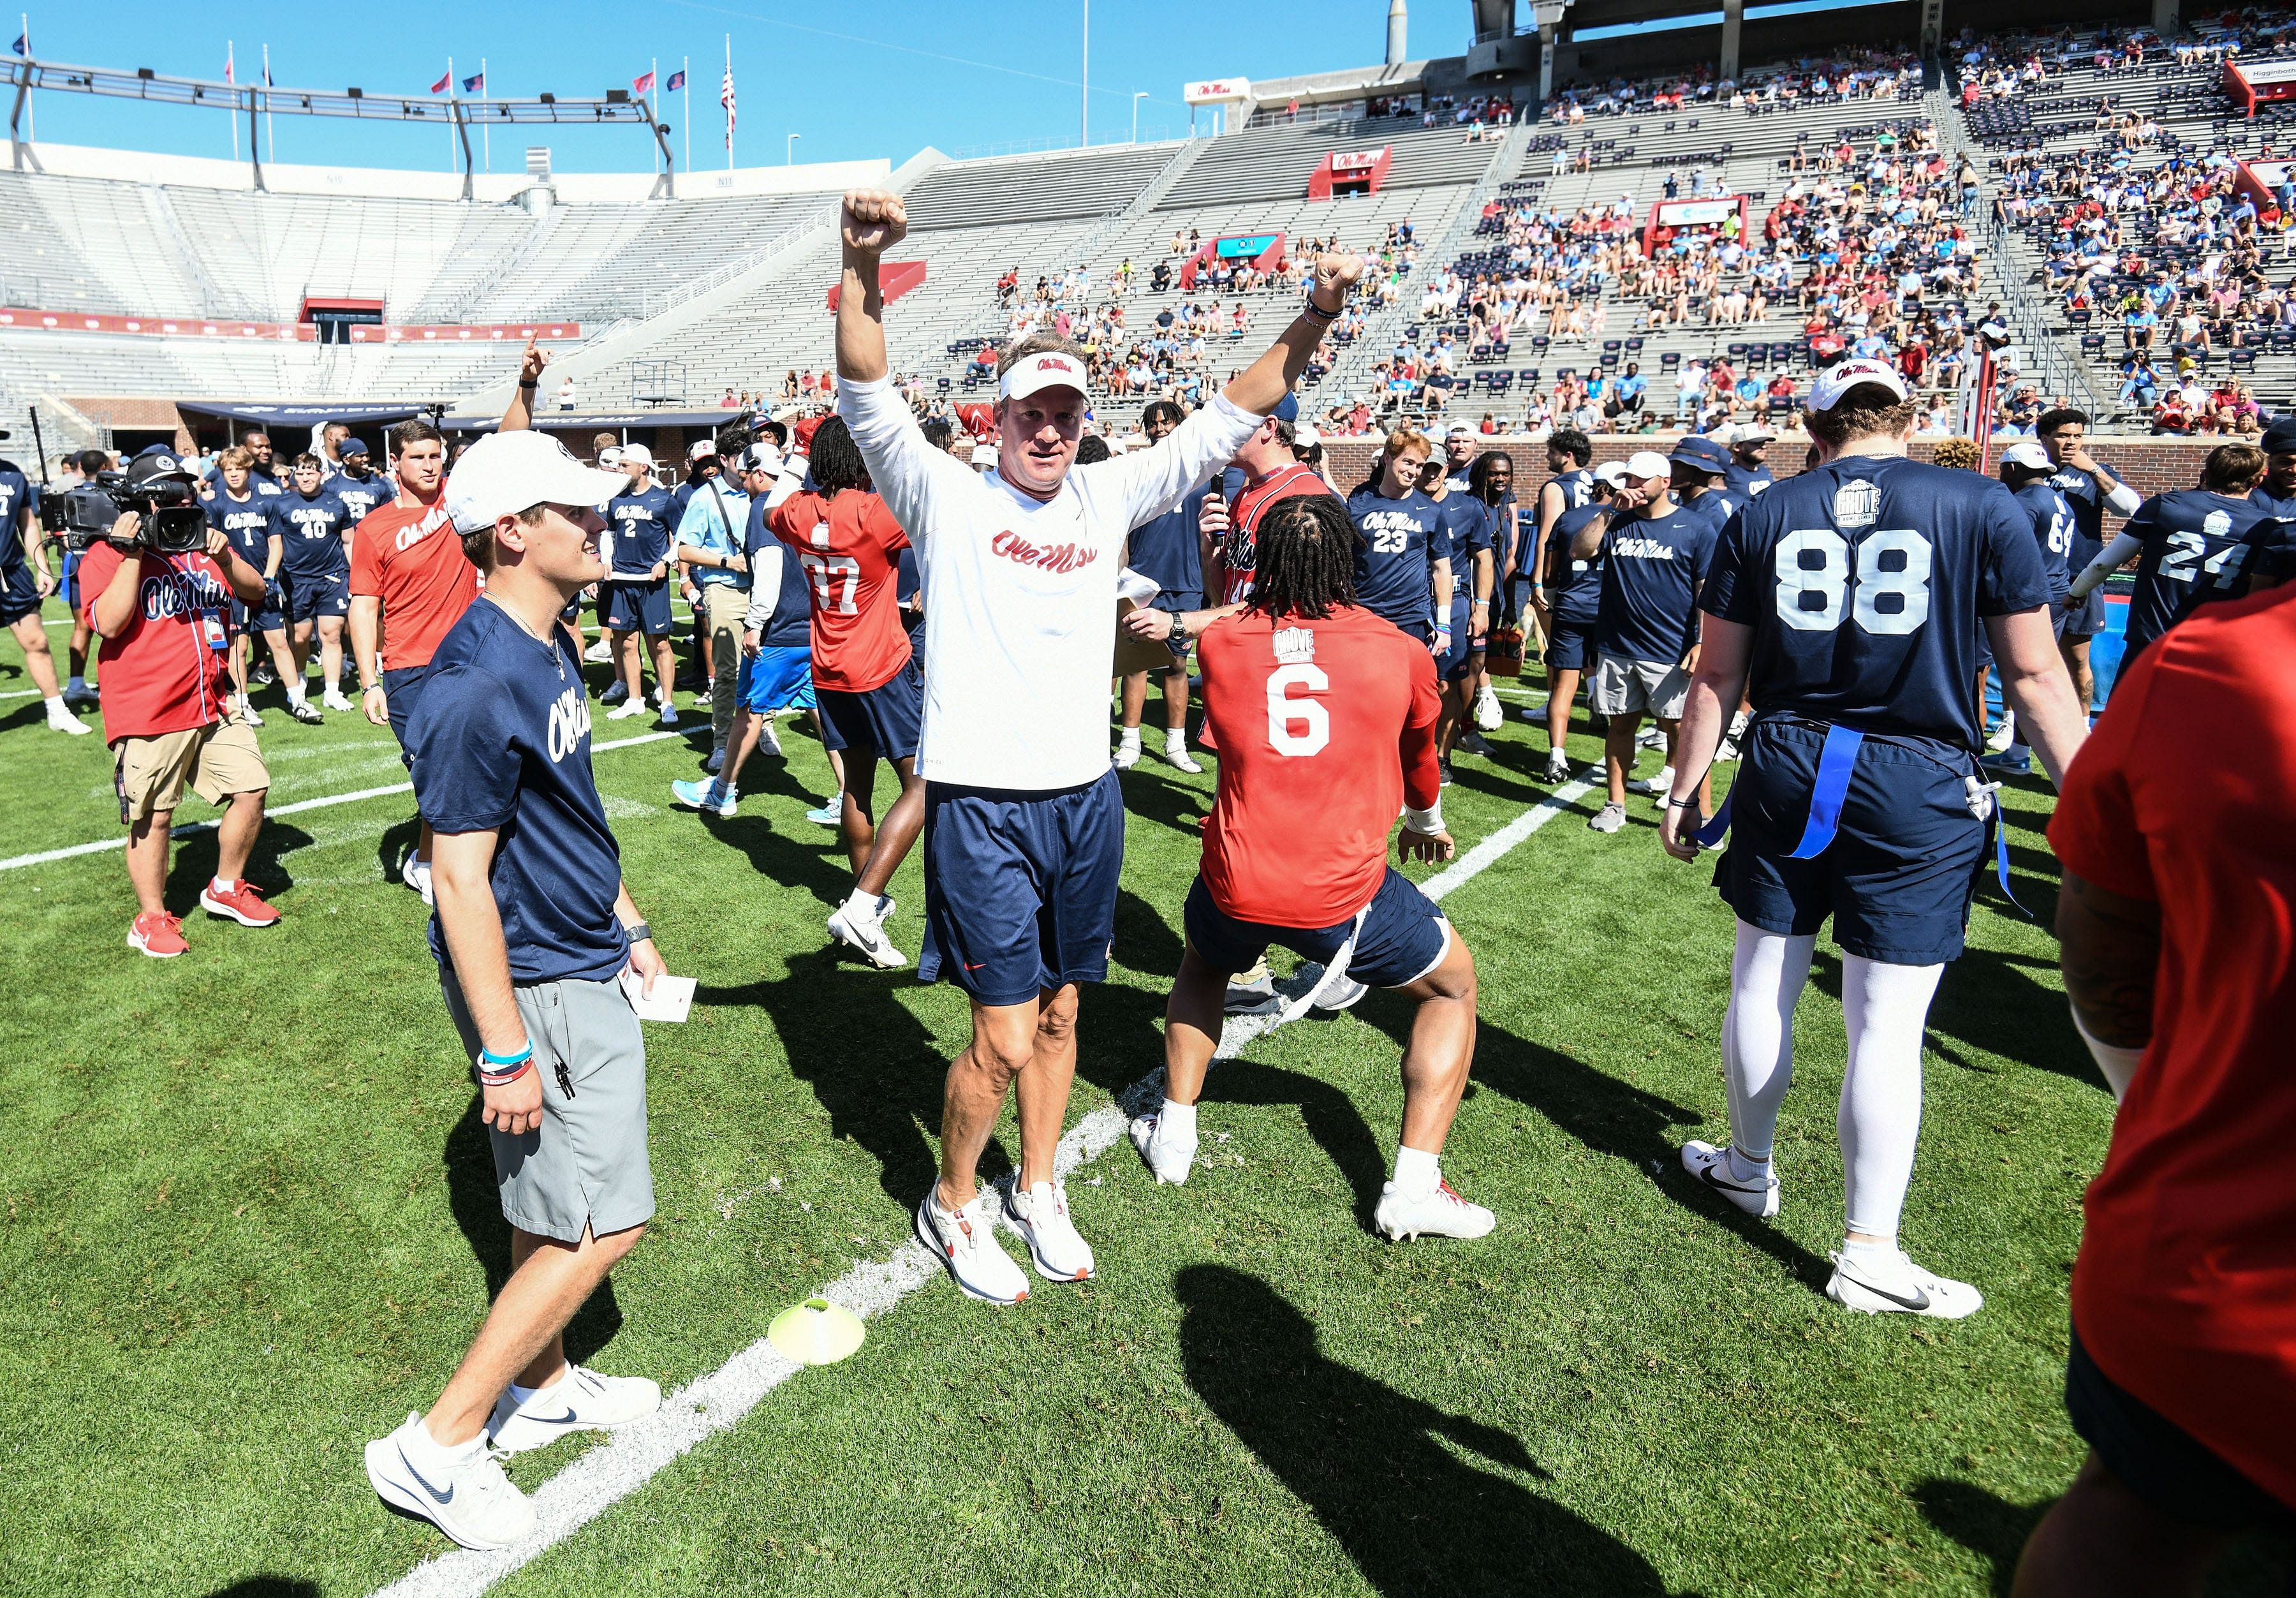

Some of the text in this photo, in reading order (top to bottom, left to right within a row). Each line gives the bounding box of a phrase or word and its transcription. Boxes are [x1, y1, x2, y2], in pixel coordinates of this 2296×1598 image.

[2253, 68, 2296, 77] Higginboth
[1198, 84, 1231, 96] Ole Miss
[1338, 153, 1379, 168] Ole Miss
[1037, 359, 1072, 373] Ole Miss
[1836, 364, 1880, 381] Ole Miss
[1444, 478, 1470, 492] Miss
[353, 491, 375, 505] Miss
[1836, 489, 1880, 517] GROVE
[224, 512, 267, 530] Ole Miss
[291, 508, 335, 523] Ole Miss
[615, 505, 653, 520] Ole Miss
[1362, 511, 1422, 533] Ole Miss
[243, 527, 254, 547] 1
[300, 521, 327, 539] 40
[395, 522, 423, 551] Ole
[624, 519, 637, 538] 2
[2047, 512, 2075, 558] 64
[992, 529, 1040, 566] Ole
[1373, 528, 1408, 553] 23
[1611, 537, 1674, 559] Ole Miss
[2157, 530, 2251, 590] 24
[800, 552, 860, 614] 37
[1776, 529, 1932, 635] 88
[141, 569, 230, 621] Ole Miss
[1266, 663, 1330, 757] 6
[548, 697, 577, 764] Ole
